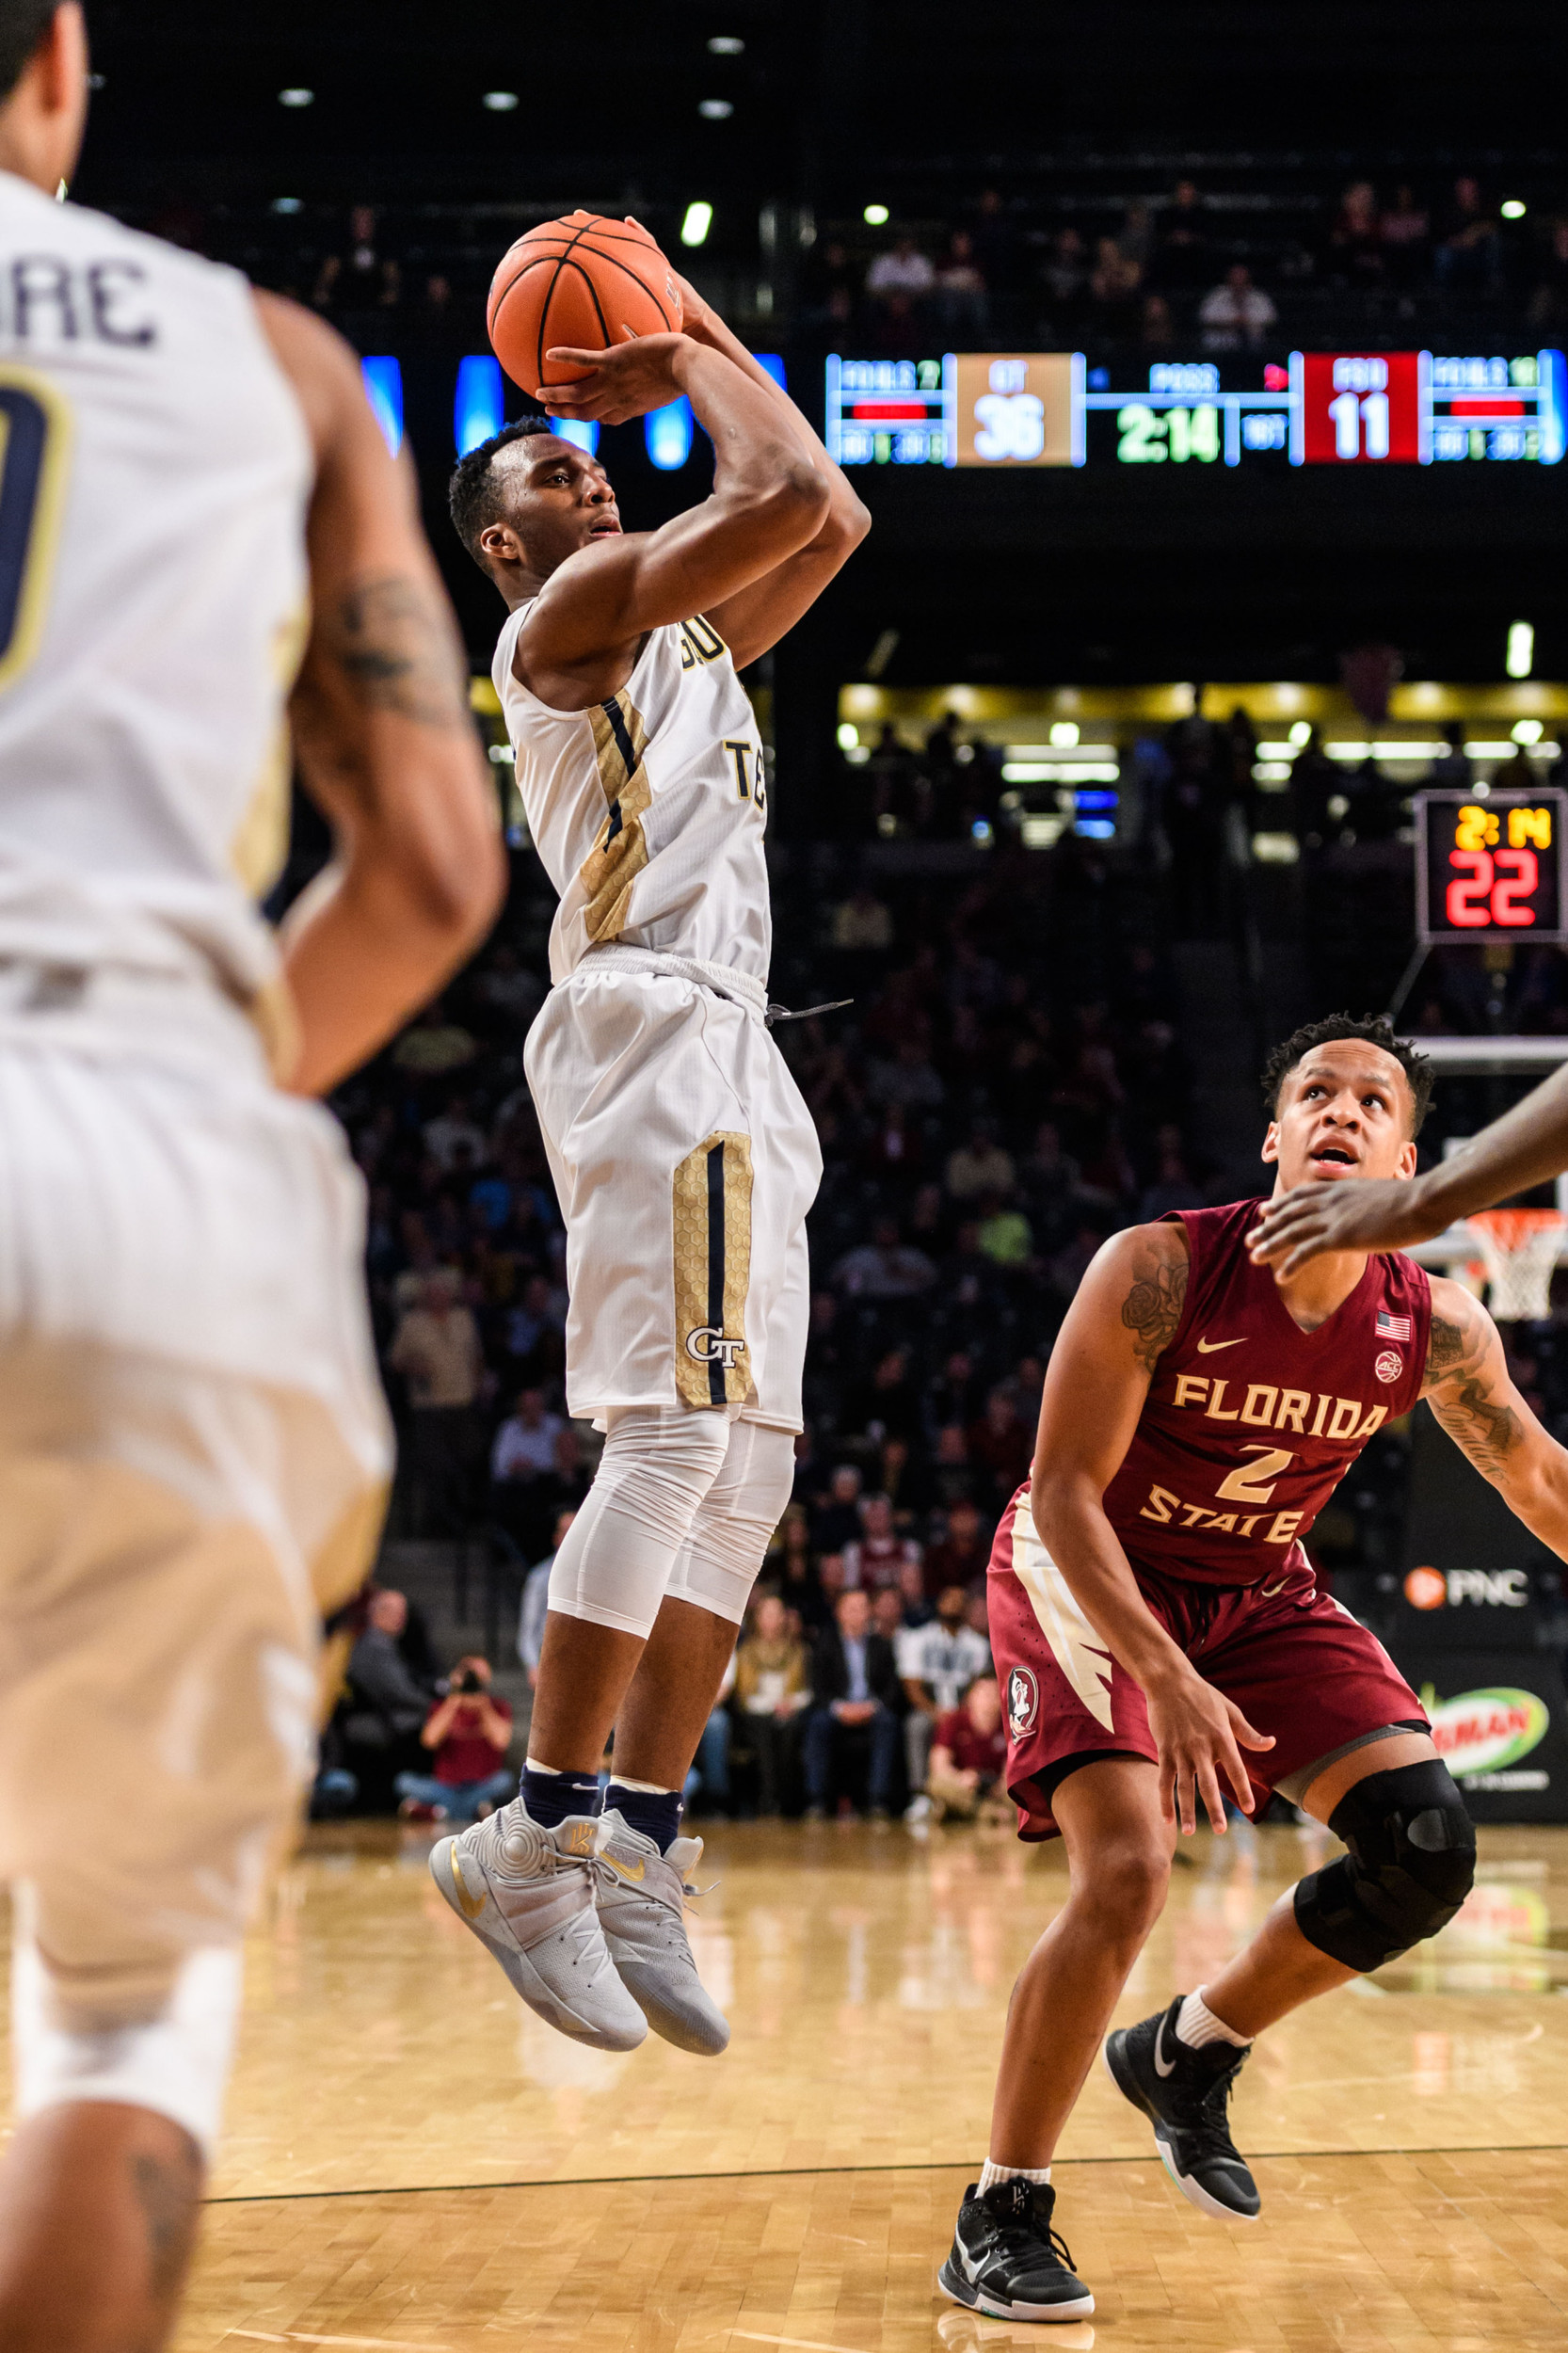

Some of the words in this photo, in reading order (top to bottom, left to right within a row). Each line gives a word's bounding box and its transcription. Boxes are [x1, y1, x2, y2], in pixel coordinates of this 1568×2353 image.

[0, 253, 156, 345] RE
[1117, 403, 1220, 462] 2:14
[1328, 392, 1389, 458] 11
[1447, 849, 1538, 926] 22
[686, 1326, 744, 1369] GT
[1377, 1360, 1401, 1372] ACC
[1172, 1373, 1388, 1439] FLORIDA
[1215, 1444, 1300, 1504] 2
[1139, 1484, 1304, 1544] STATE
[1447, 1569, 1528, 1607] PNC
